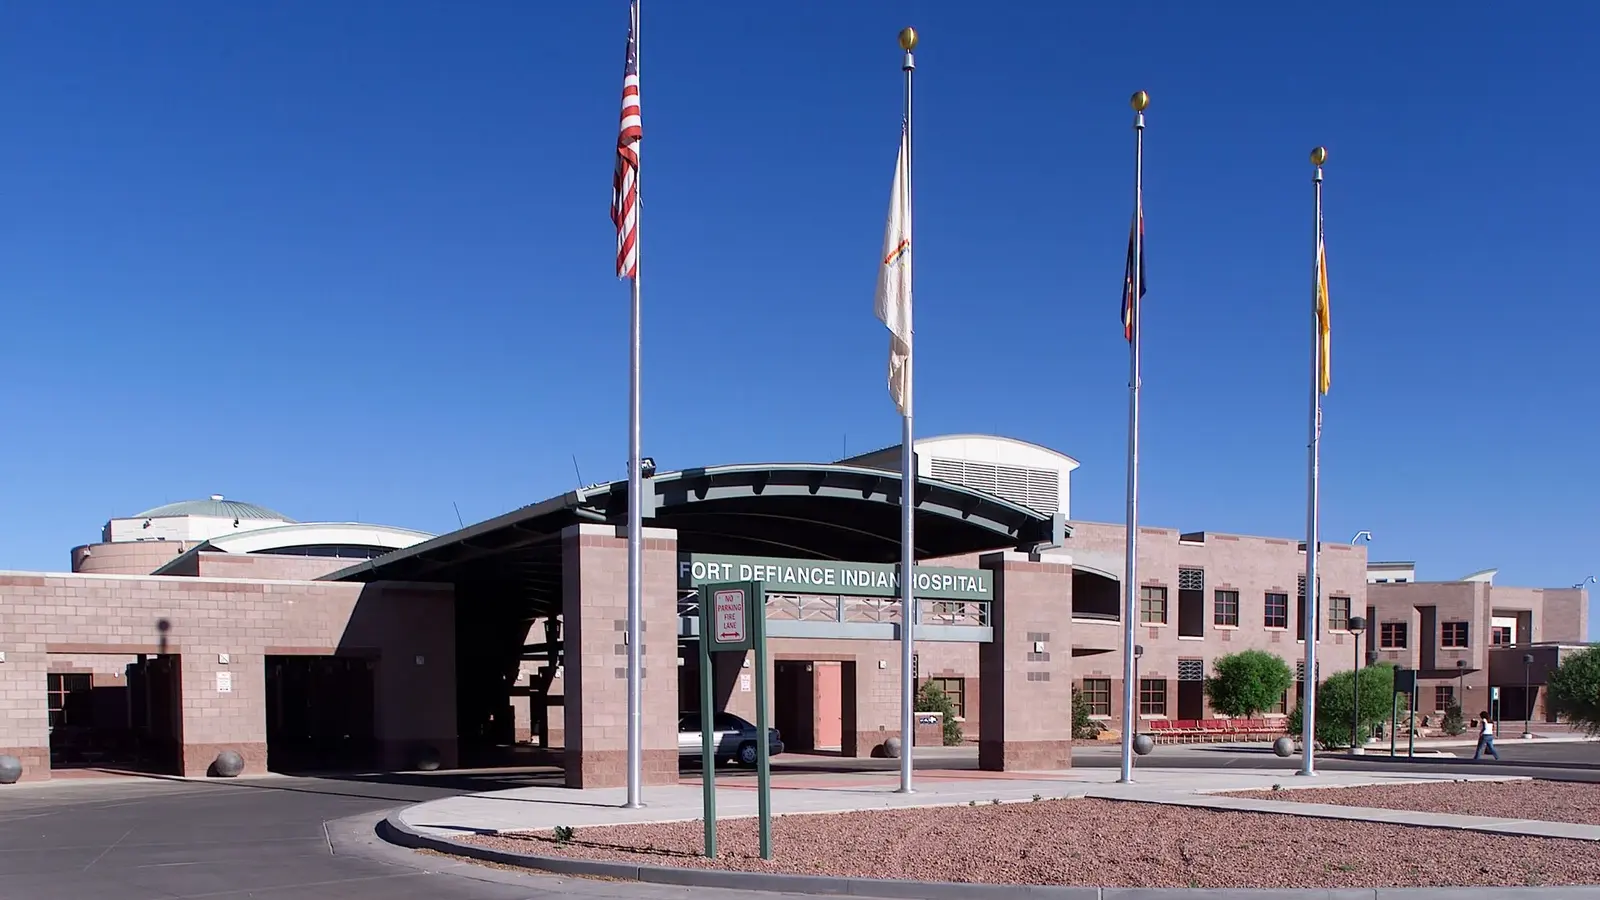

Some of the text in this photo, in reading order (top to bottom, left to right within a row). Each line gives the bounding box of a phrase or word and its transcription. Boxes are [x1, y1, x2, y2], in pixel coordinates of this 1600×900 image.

[679, 561, 733, 580] FORT
[740, 564, 835, 585] DEFIANCE
[841, 569, 900, 588] INDIAN
[718, 604, 742, 612] PARKING
